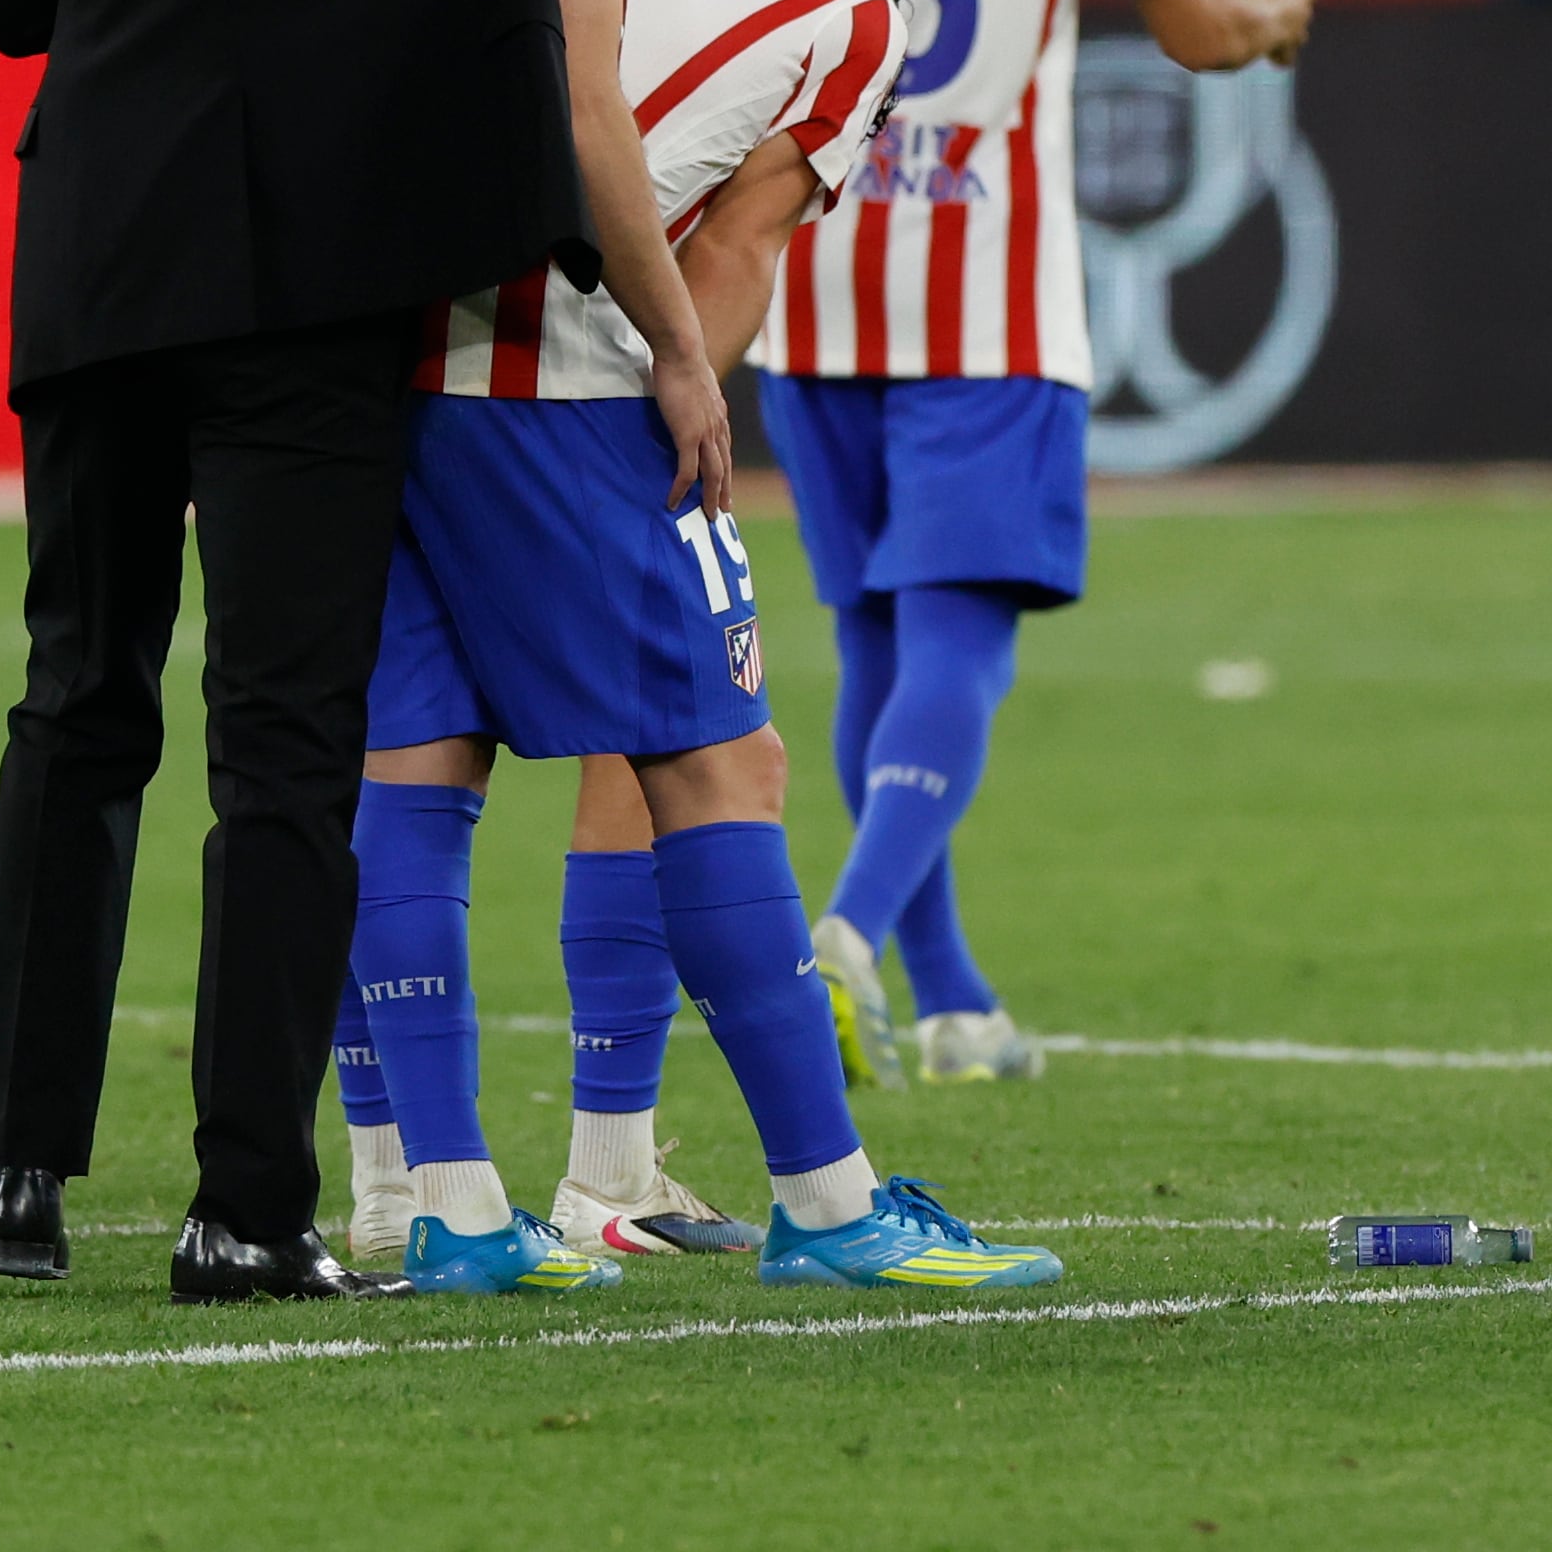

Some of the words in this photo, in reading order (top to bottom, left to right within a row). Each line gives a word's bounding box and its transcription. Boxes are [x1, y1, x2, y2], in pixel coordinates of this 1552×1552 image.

[869, 120, 960, 159] SIT
[850, 162, 989, 201] ANDA
[675, 505, 754, 615] 19
[361, 976, 447, 1005] ATLETI
